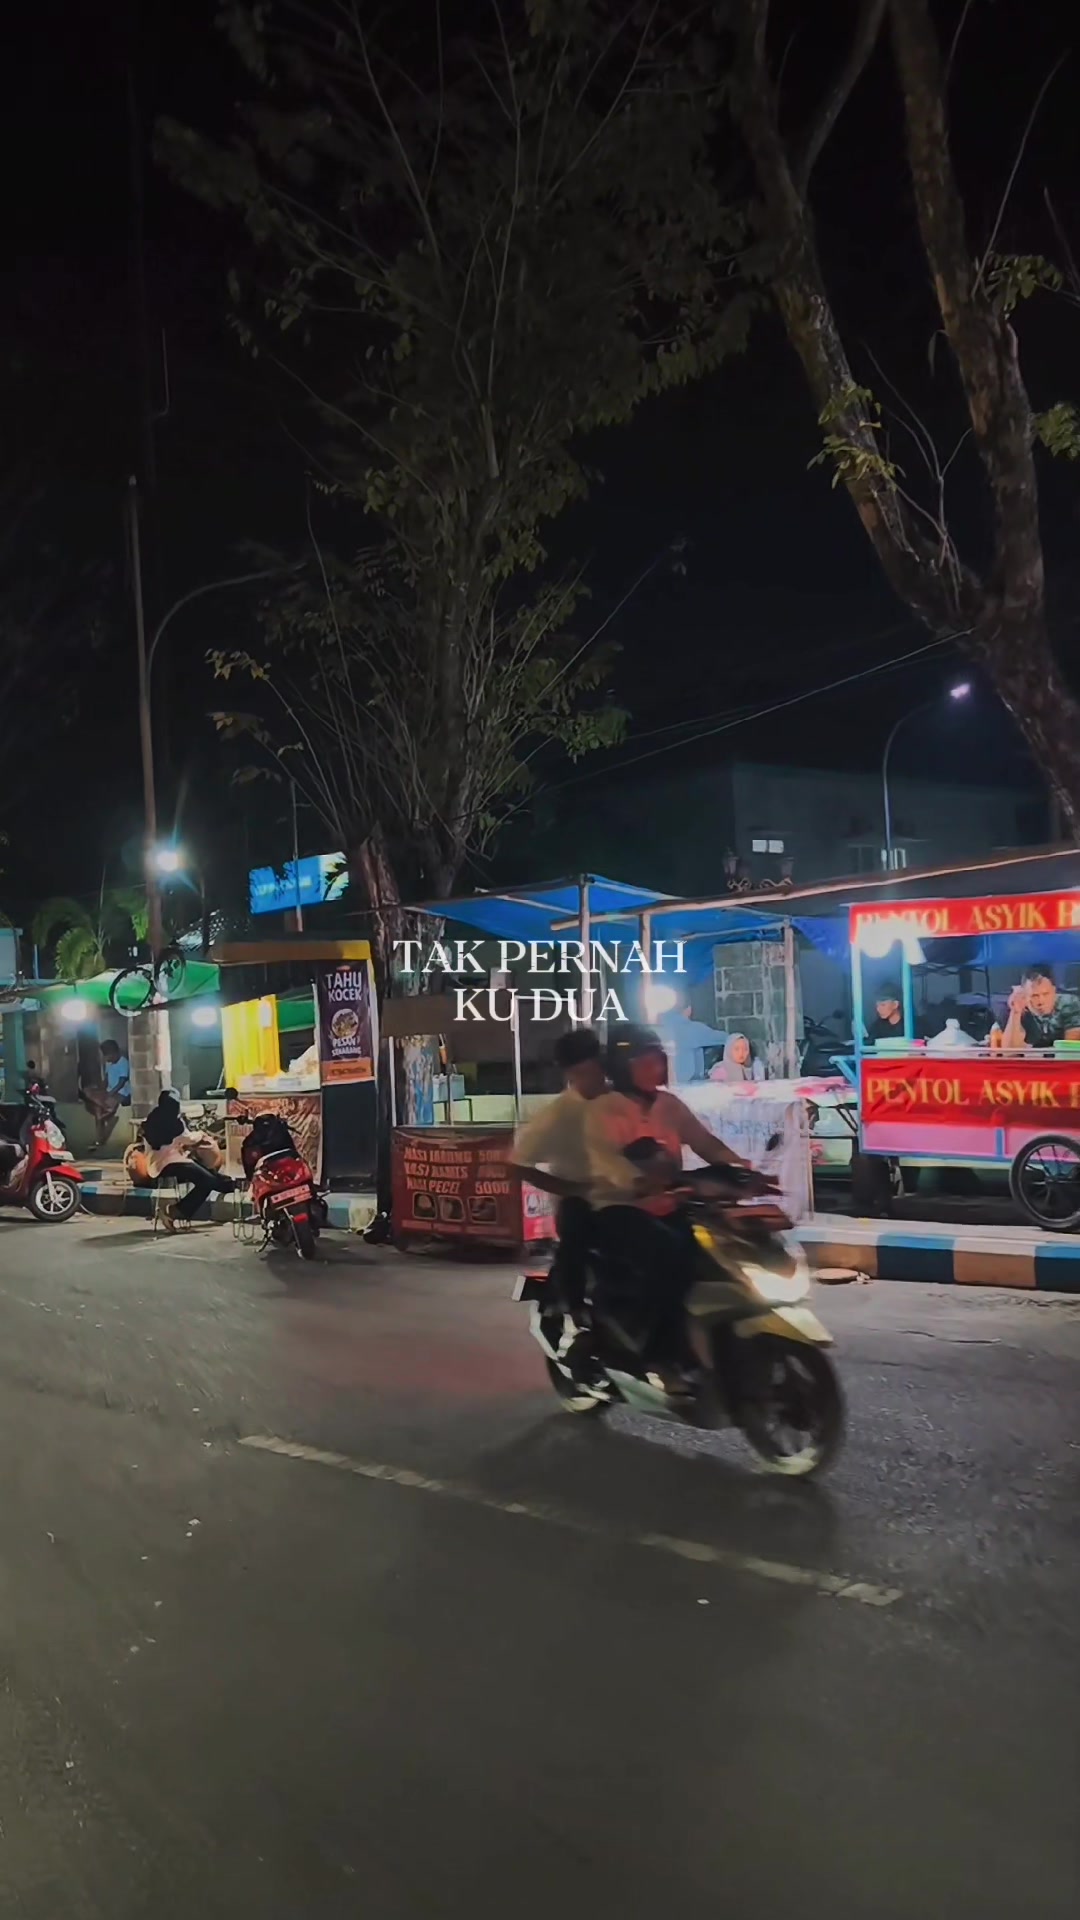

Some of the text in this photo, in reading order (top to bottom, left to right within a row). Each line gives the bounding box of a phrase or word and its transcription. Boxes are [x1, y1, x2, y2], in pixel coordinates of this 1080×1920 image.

[857, 908, 957, 934] TOL
[969, 902, 1047, 930] ASYIK
[325, 972, 362, 990] TAHU
[328, 988, 362, 1002] KOCEK
[866, 1077, 970, 1105] PENTOL
[979, 1079, 1061, 1108] ASYIK
